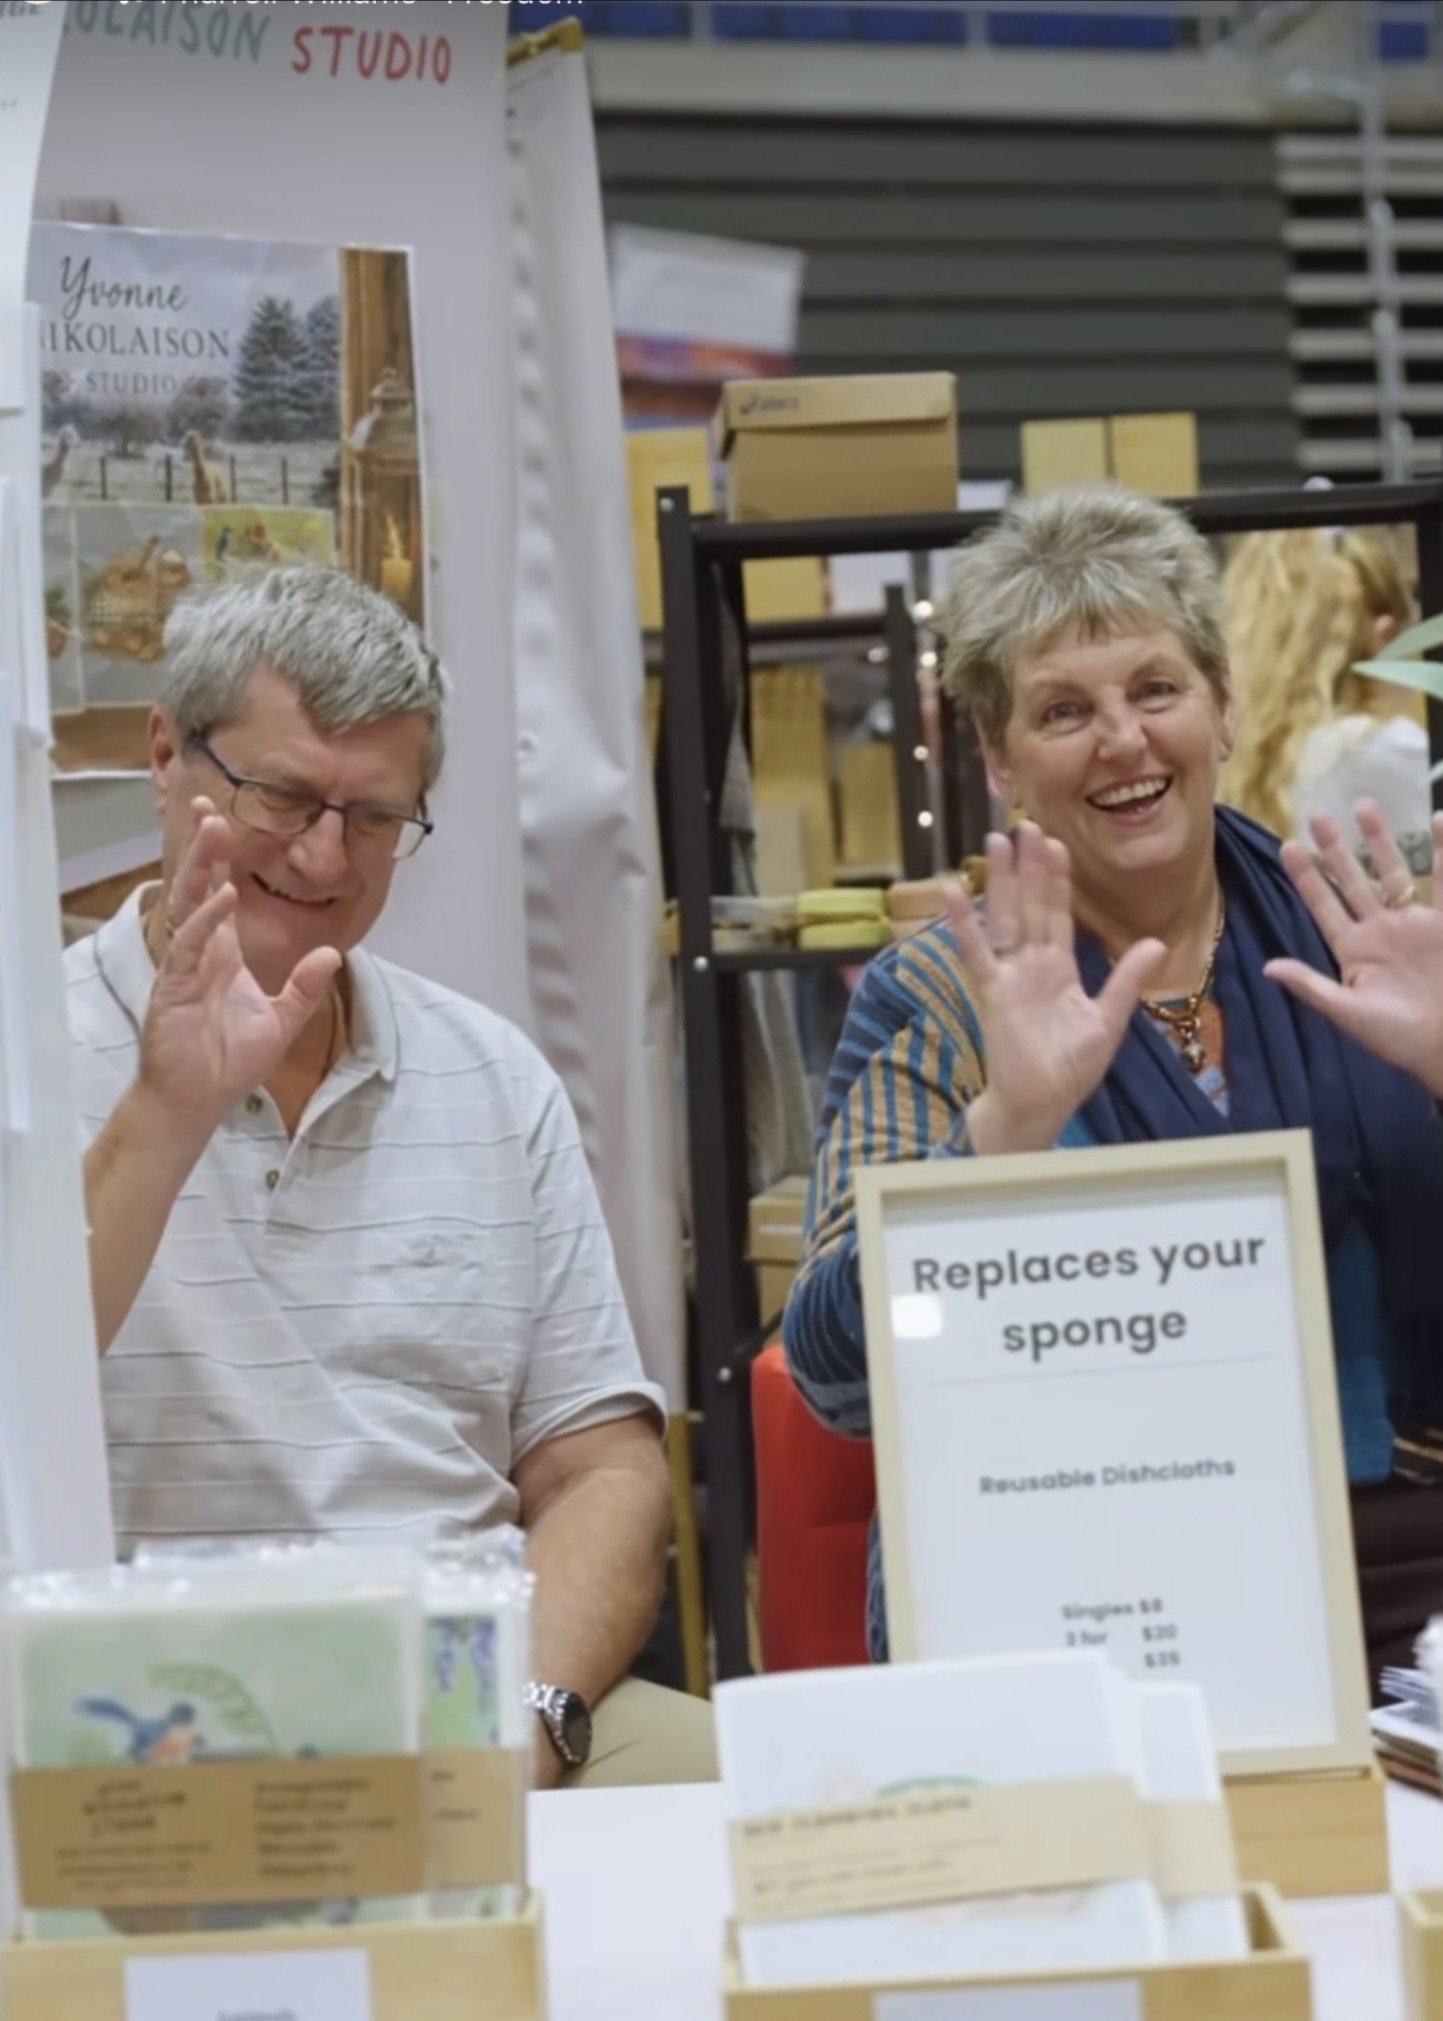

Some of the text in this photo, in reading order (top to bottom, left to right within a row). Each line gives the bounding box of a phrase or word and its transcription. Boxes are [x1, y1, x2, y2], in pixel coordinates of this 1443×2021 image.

[291, 27, 452, 84] STUDIO
[60, 255, 188, 318] Yvonne
[85, 370, 177, 395] STUDIO
[912, 1235, 1266, 1300] Replaces your
[1002, 1309, 1188, 1361] sponge
[979, 1457, 1236, 1496] Reusable Dishcloths
[1062, 1603, 1134, 1622] Singles
